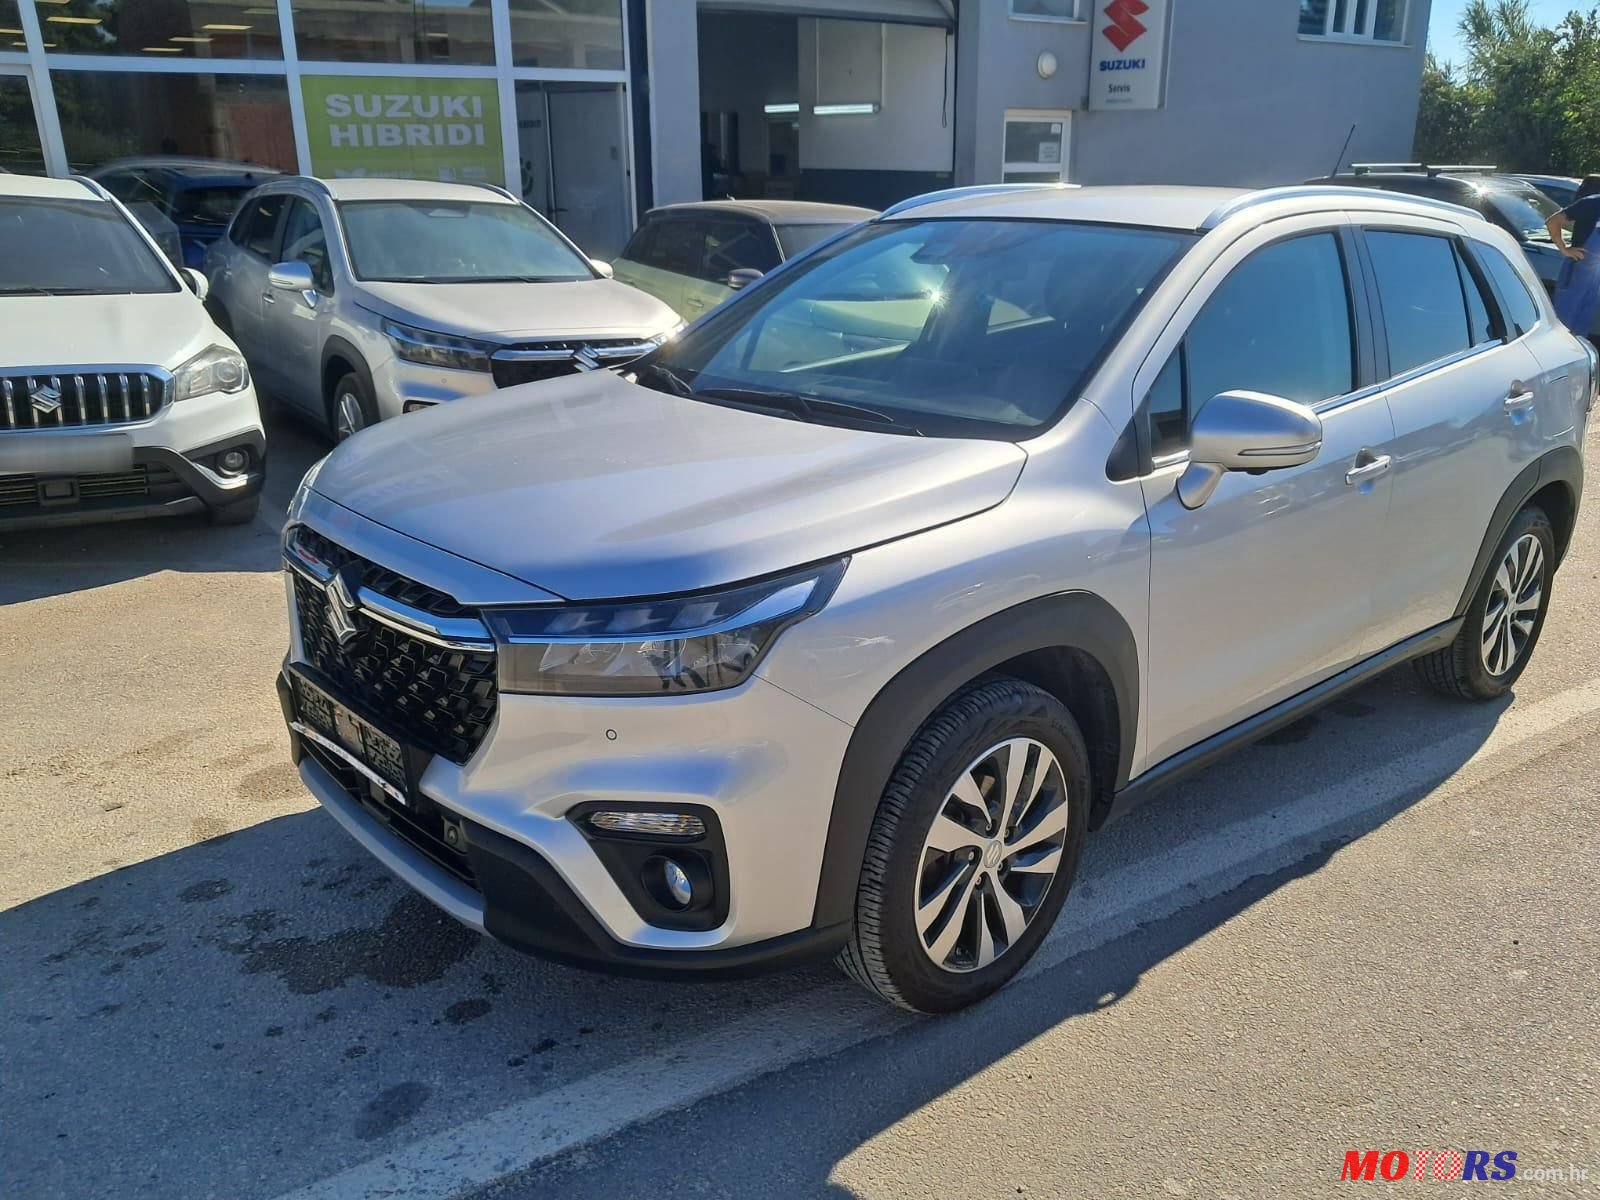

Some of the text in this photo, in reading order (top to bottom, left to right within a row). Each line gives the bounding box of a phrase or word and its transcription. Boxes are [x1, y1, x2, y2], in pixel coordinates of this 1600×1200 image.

[1099, 58, 1146, 71] SUZUKI
[326, 94, 482, 118] SUZUKI
[330, 124, 485, 147] HIBRIDI
